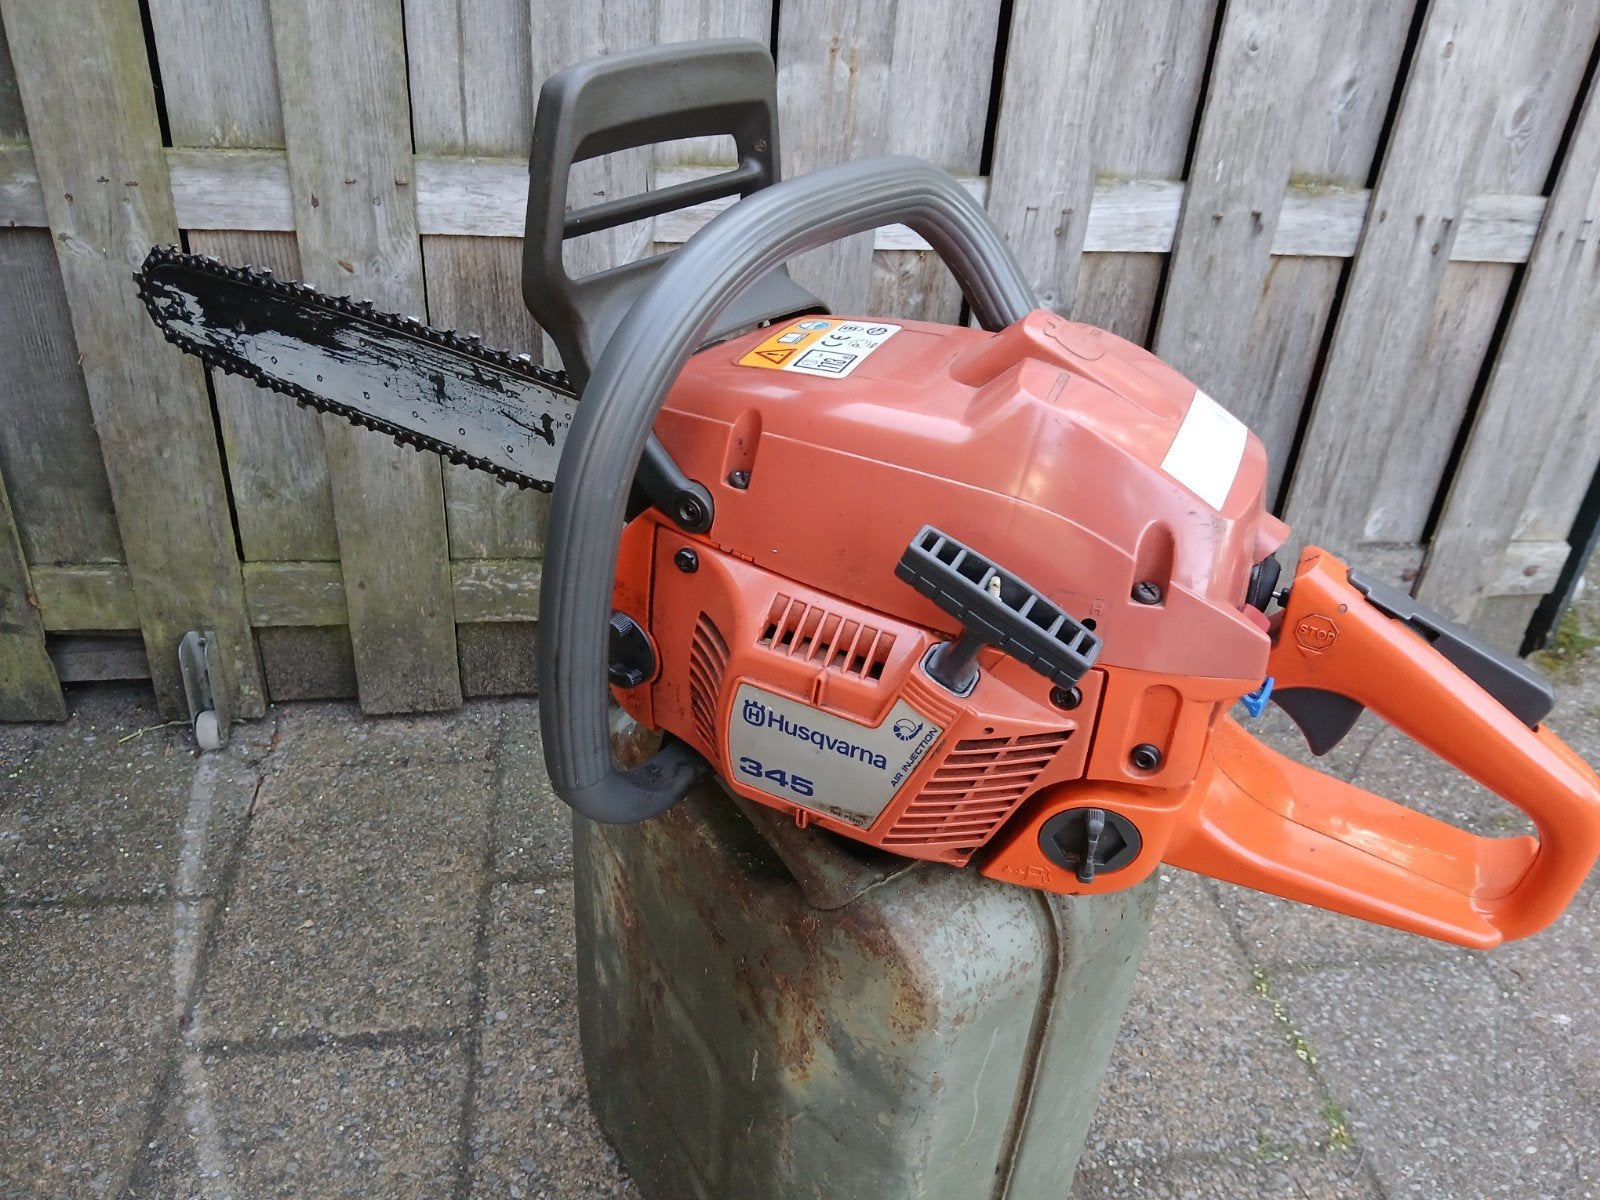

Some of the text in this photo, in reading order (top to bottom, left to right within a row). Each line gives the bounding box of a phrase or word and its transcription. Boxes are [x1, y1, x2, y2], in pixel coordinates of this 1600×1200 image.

[821, 334, 851, 347] CE
[1299, 624, 1335, 641] STOP
[767, 710, 887, 770] Husqvarna
[891, 727, 938, 788] AIR INJECTION
[739, 756, 814, 797] 345
